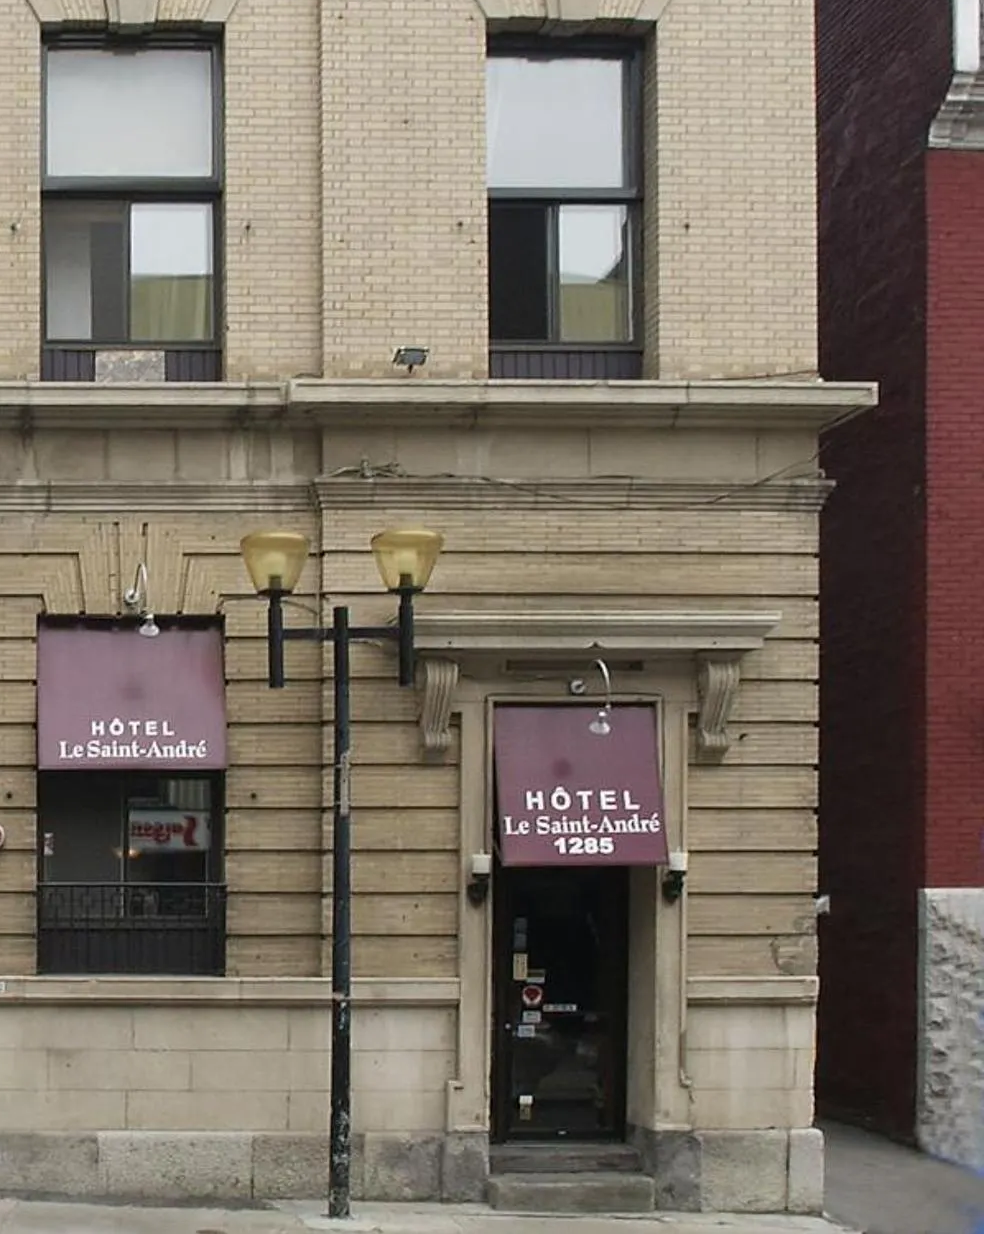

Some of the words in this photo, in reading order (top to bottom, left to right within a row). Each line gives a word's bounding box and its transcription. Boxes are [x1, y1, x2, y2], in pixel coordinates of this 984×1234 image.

[91, 717, 175, 736] HÔTEL
[59, 739, 84, 758] Le
[86, 739, 208, 758] Saint-André
[525, 786, 641, 811] HÔTEL
[503, 816, 530, 835] Le
[536, 813, 661, 835] Saint-André
[553, 837, 614, 855] 1285
